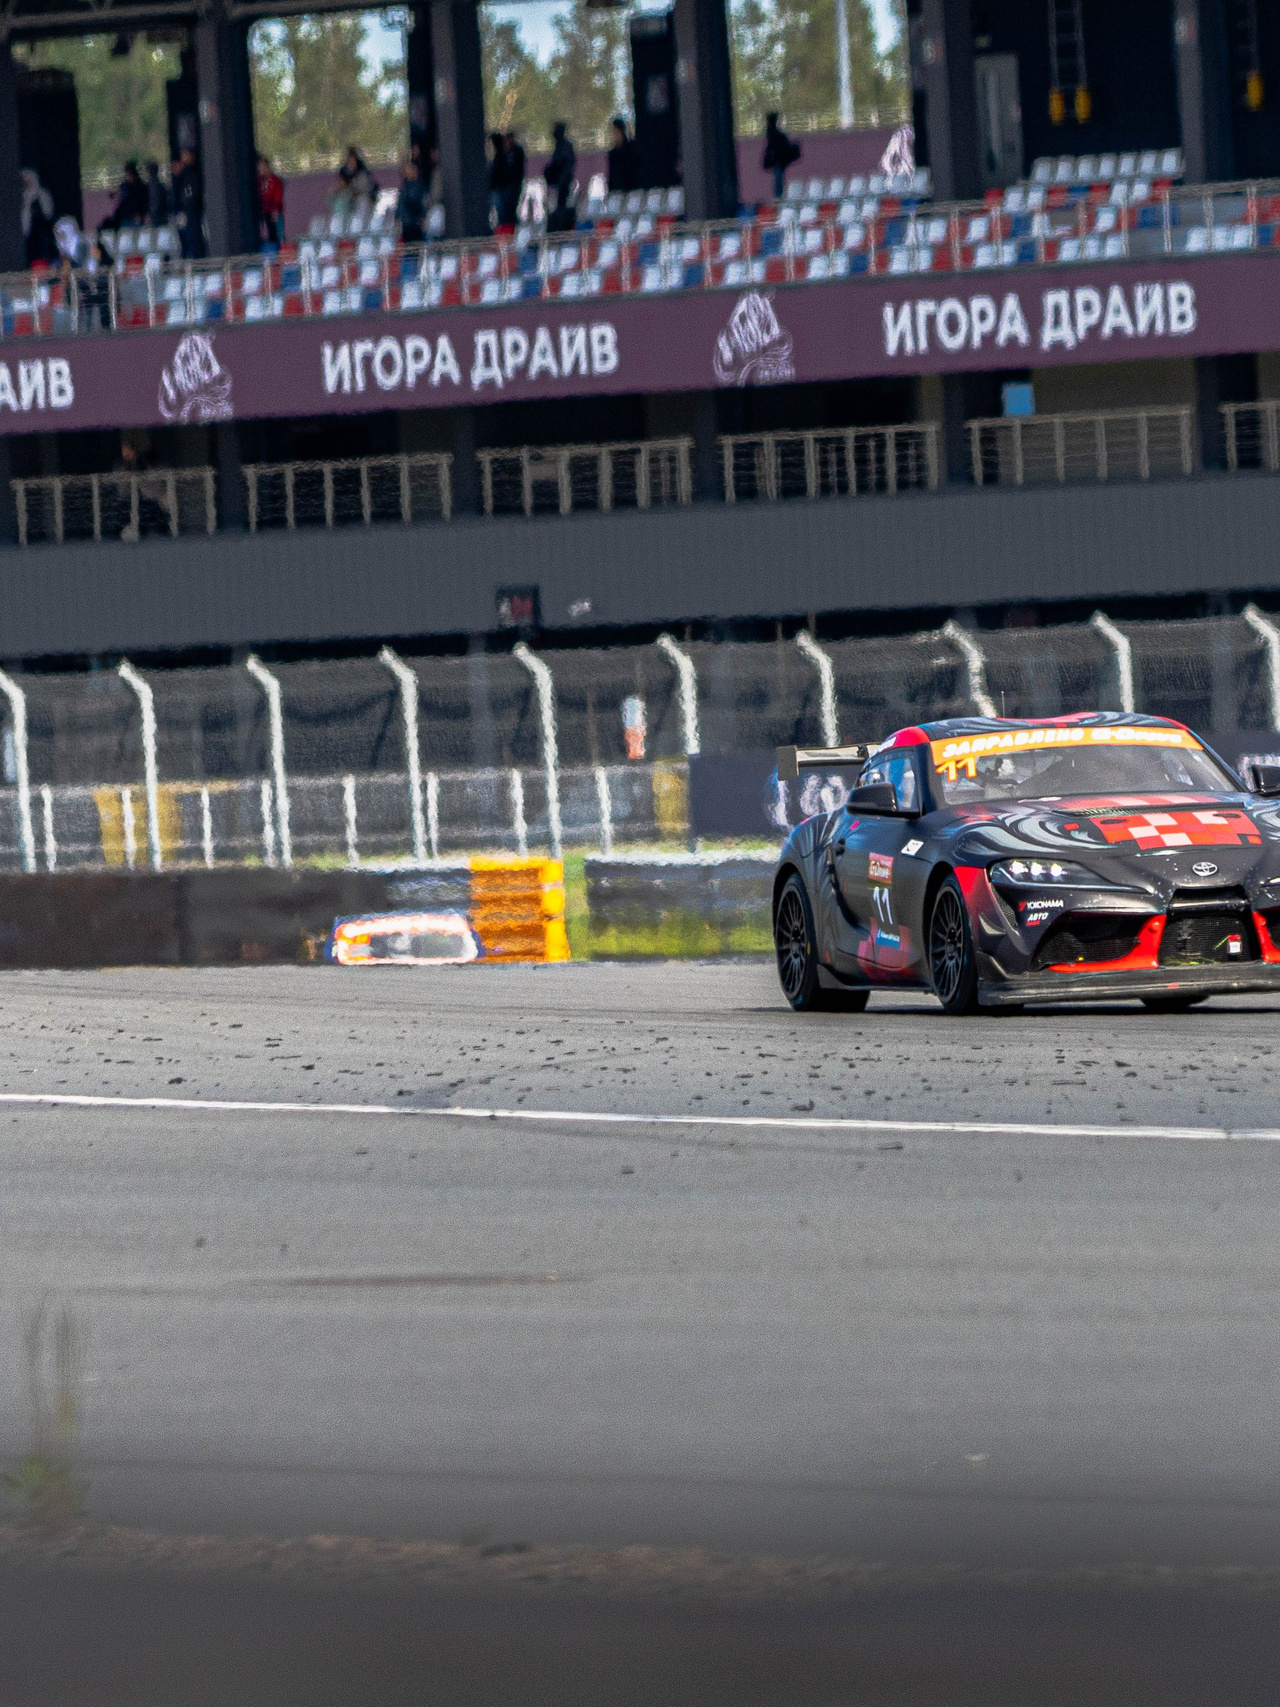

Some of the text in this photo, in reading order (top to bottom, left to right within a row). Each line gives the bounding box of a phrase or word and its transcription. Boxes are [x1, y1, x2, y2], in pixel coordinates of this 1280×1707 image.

[883, 292, 1029, 357] ИГОРА
[321, 334, 462, 394] ИГОРА
[943, 728, 1084, 757] ЗАПРАВЛЕНО
[936, 756, 977, 782] 11
[872, 886, 893, 925] 11
[1026, 899, 1064, 909] YOKOHAMA
